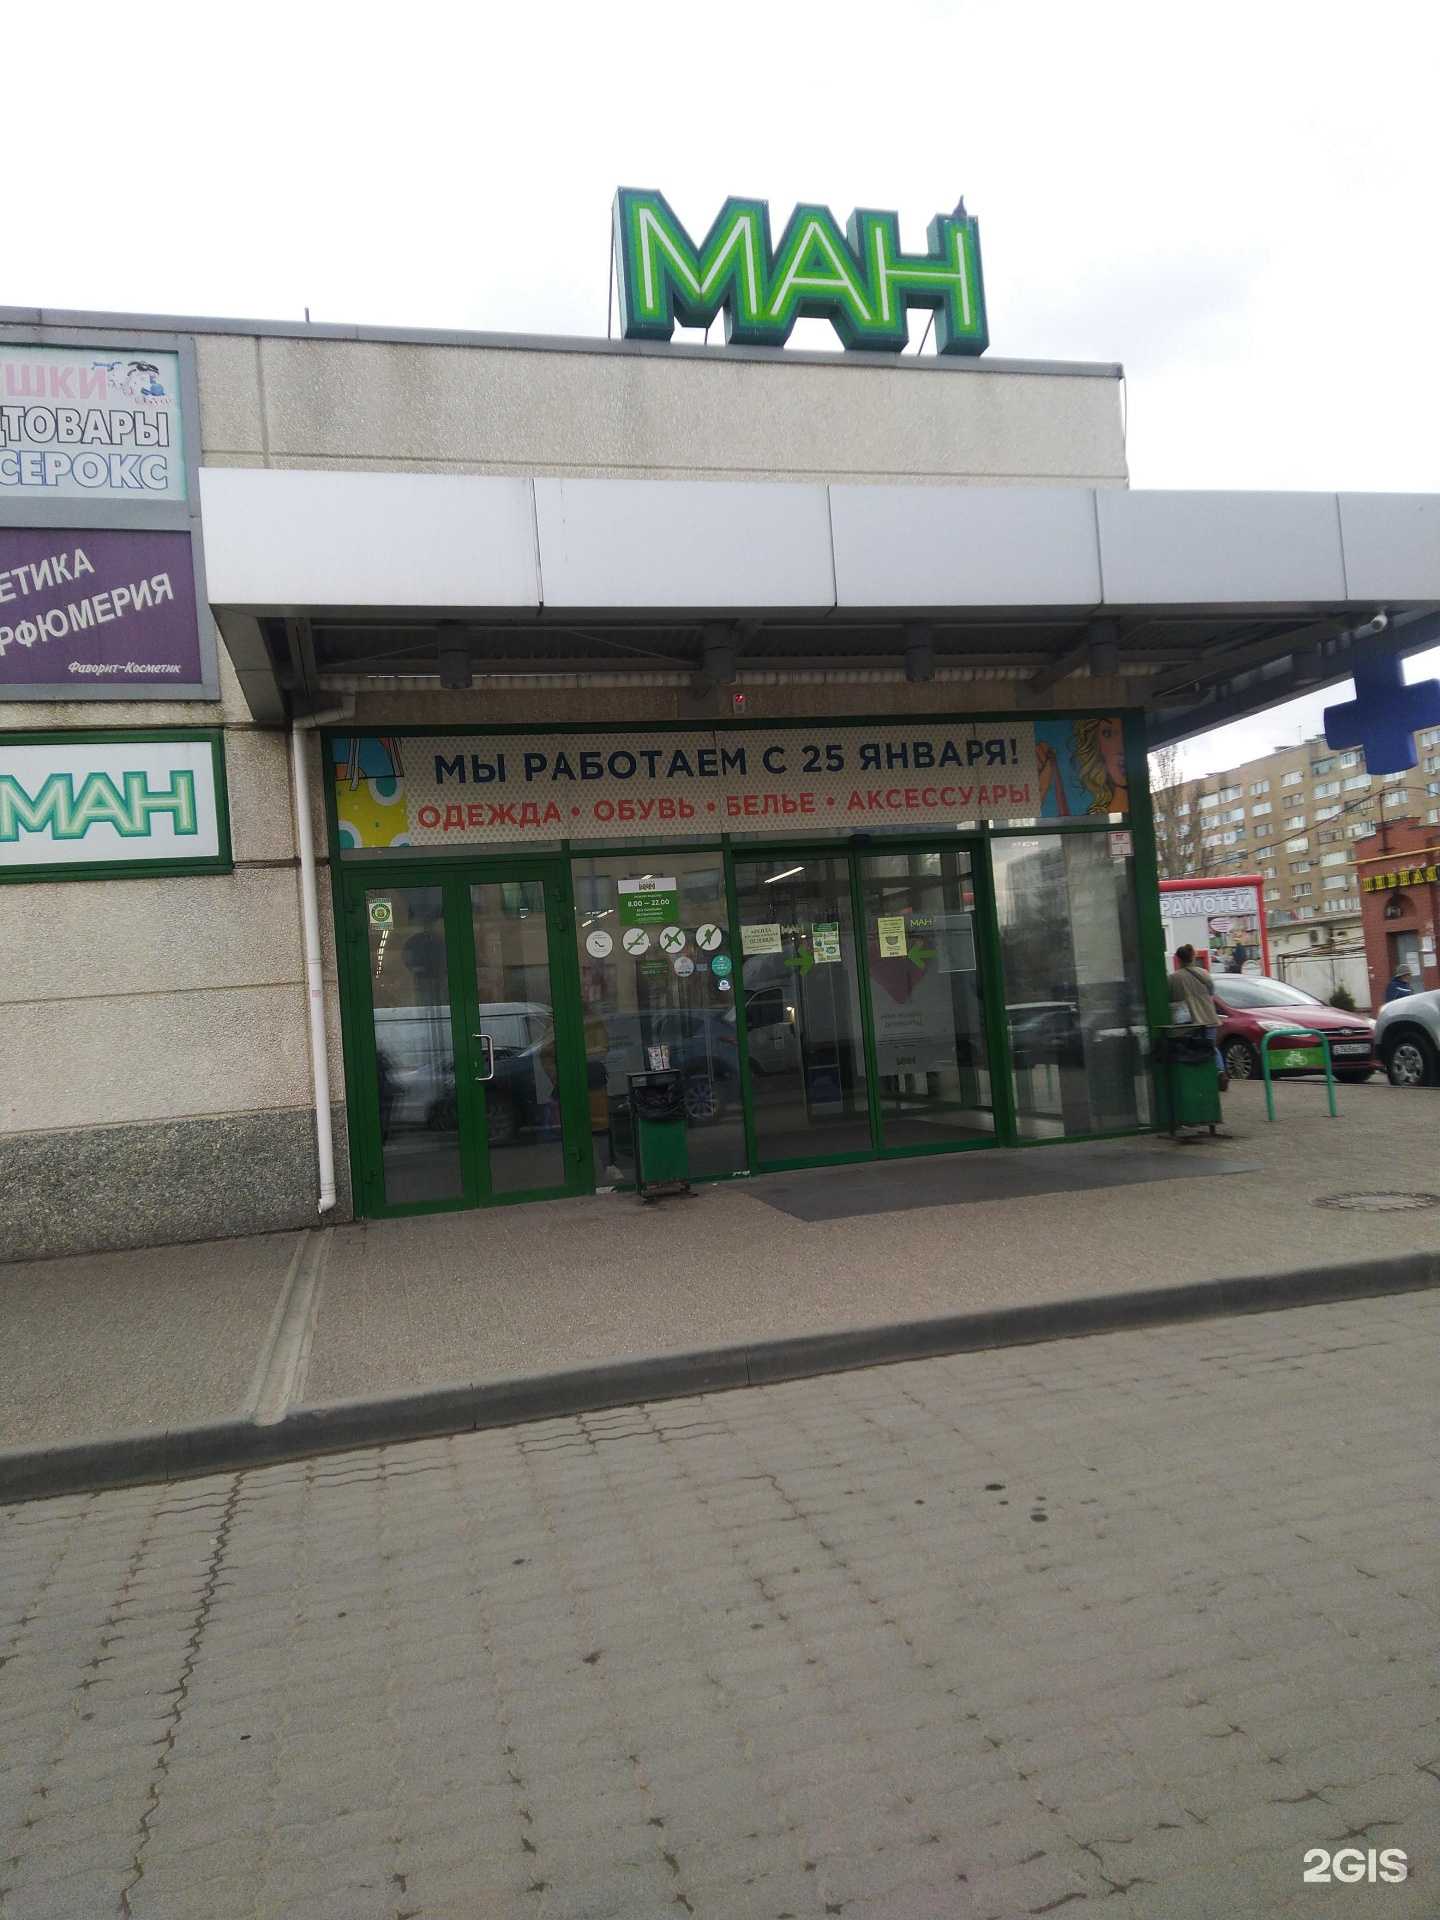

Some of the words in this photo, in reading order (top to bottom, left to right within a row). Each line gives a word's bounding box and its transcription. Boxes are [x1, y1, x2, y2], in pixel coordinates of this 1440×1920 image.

[616, 186, 990, 357] МАН
[0, 362, 109, 401] ШКИ
[0, 405, 169, 448] ТОВАРЫ
[0, 449, 169, 491] СЕРОКС
[0, 573, 174, 656] РФЮМЕРИЯ
[434, 752, 506, 784] МЫ
[524, 748, 747, 782] РАБОТАЕМ
[762, 744, 787, 774] С
[802, 742, 845, 773] 25
[859, 740, 1019, 771] ЯНВАРЯ!
[0, 770, 198, 842] МАН
[417, 801, 562, 831] ОДЕЖДА
[593, 797, 695, 823] ОБУВЬ
[726, 792, 817, 816] БЕЛЬЕ
[847, 783, 1031, 812] АКСЕССУАРЫ
